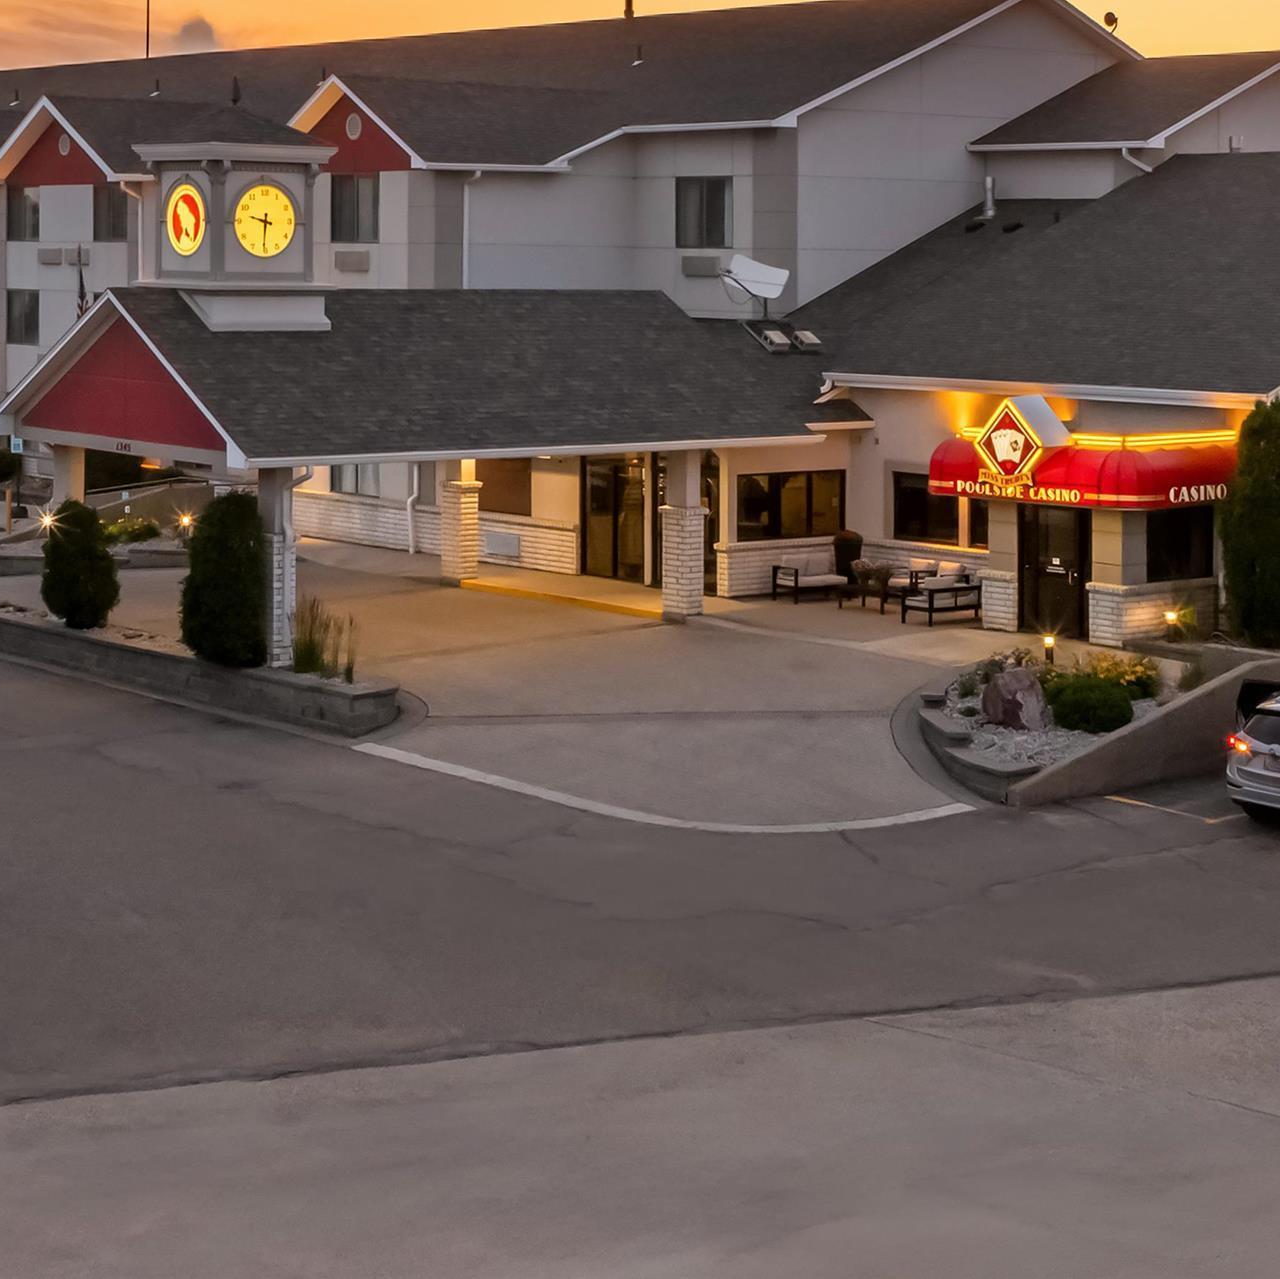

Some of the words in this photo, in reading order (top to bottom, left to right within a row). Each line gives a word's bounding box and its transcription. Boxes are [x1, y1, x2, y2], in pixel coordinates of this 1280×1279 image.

[956, 480, 1024, 498] POOLSIDE
[1029, 486, 1081, 503] CASINO
[1169, 483, 1227, 503] CASINO
